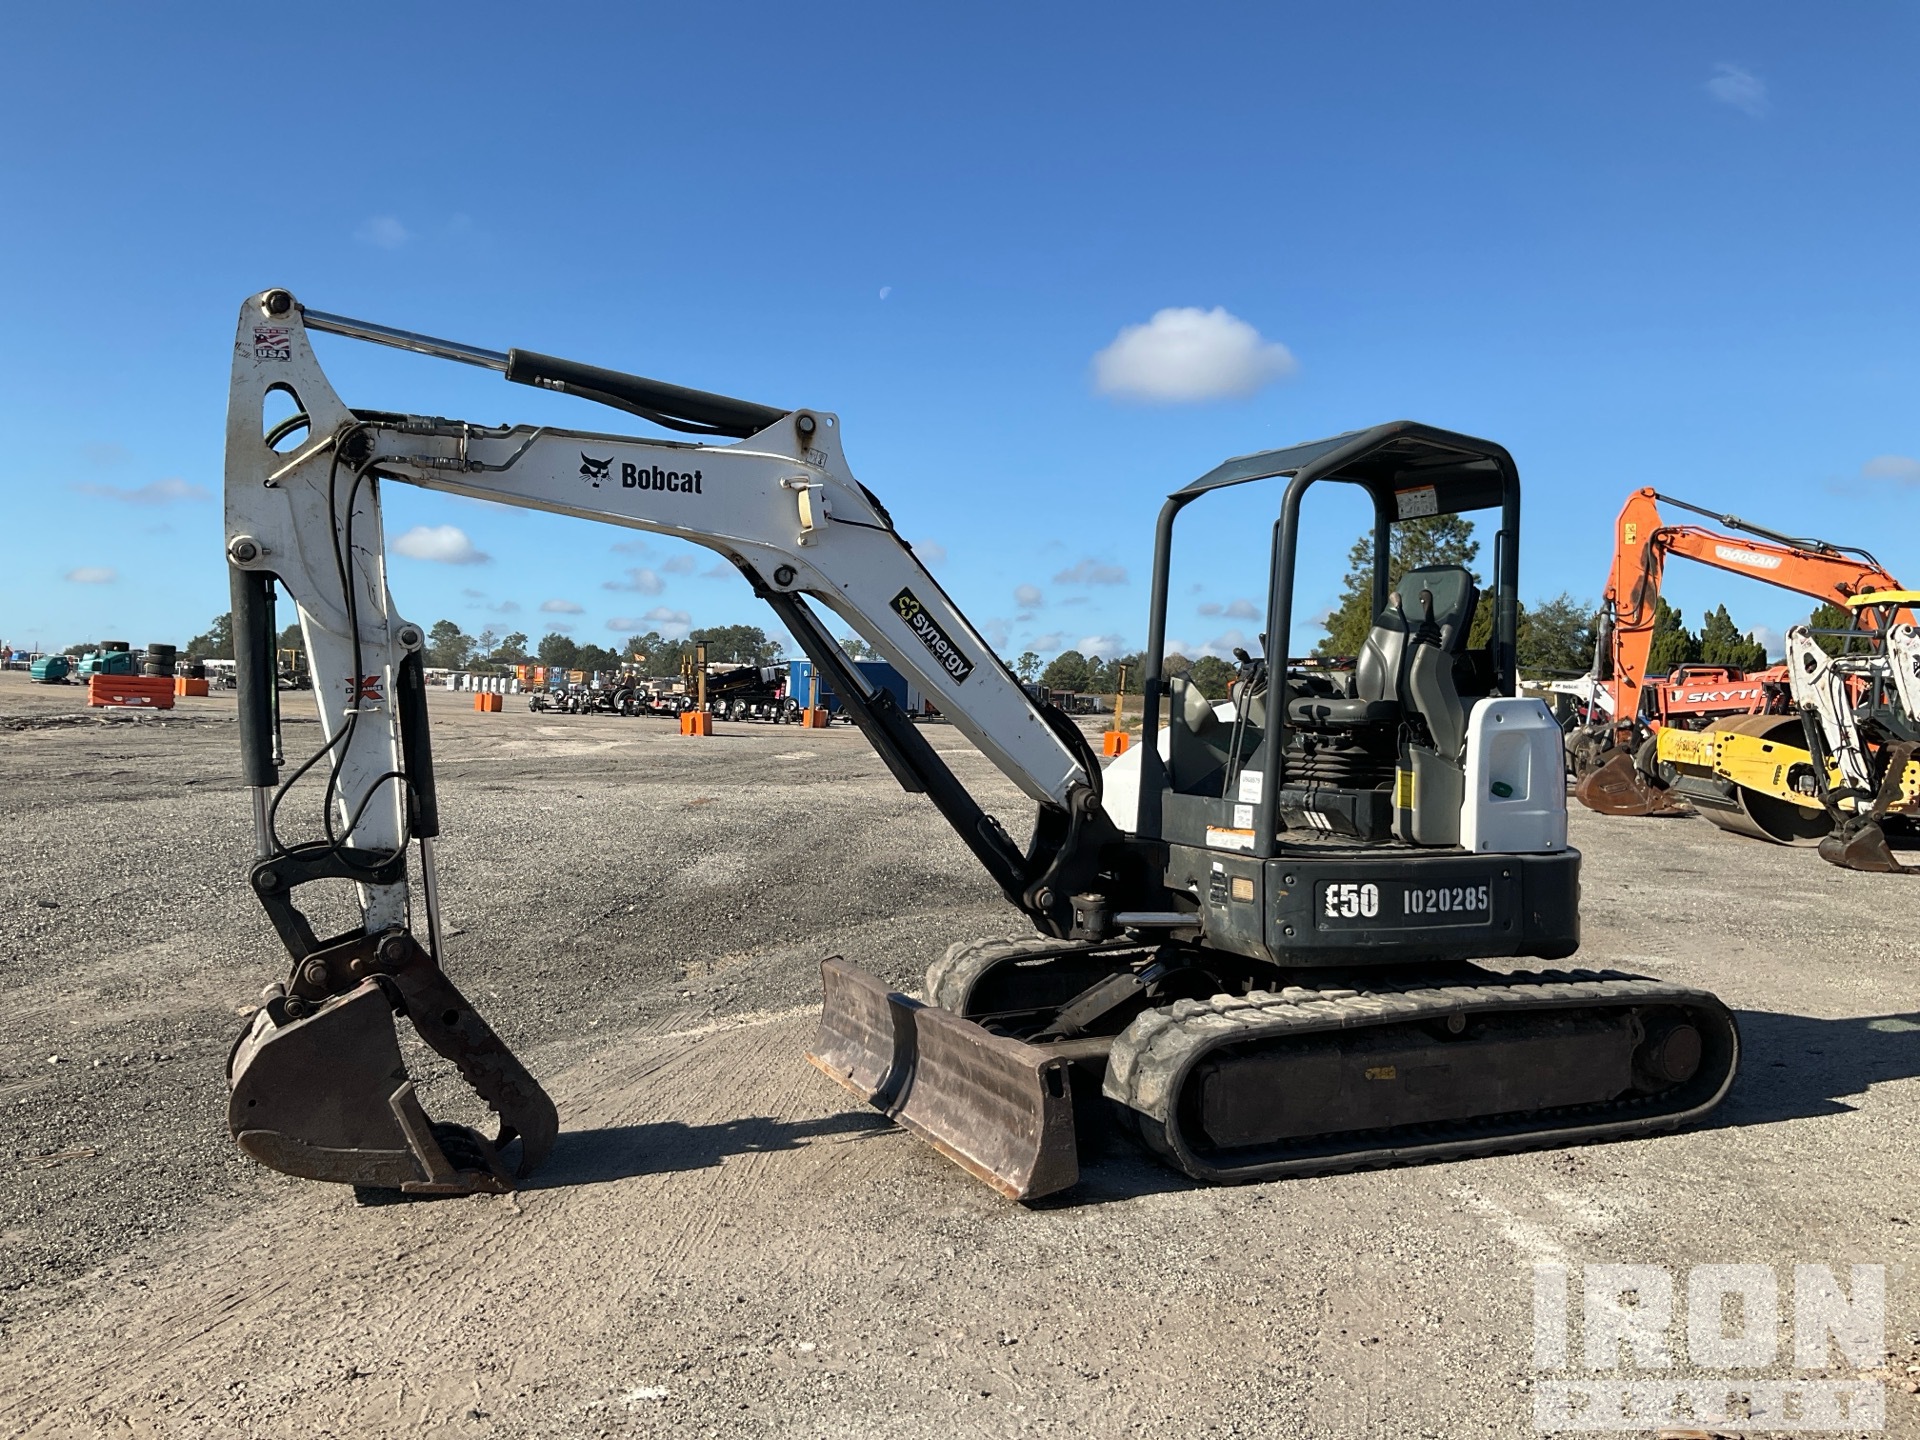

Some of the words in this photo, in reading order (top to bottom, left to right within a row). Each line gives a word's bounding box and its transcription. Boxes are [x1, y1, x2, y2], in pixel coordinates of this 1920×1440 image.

[257, 349, 288, 358] USA
[621, 462, 703, 494] Bobcat
[1719, 547, 1777, 567] DOOSAN
[912, 613, 970, 677] synergy
[1324, 883, 1379, 918] E50
[1403, 886, 1488, 915] 1020285
